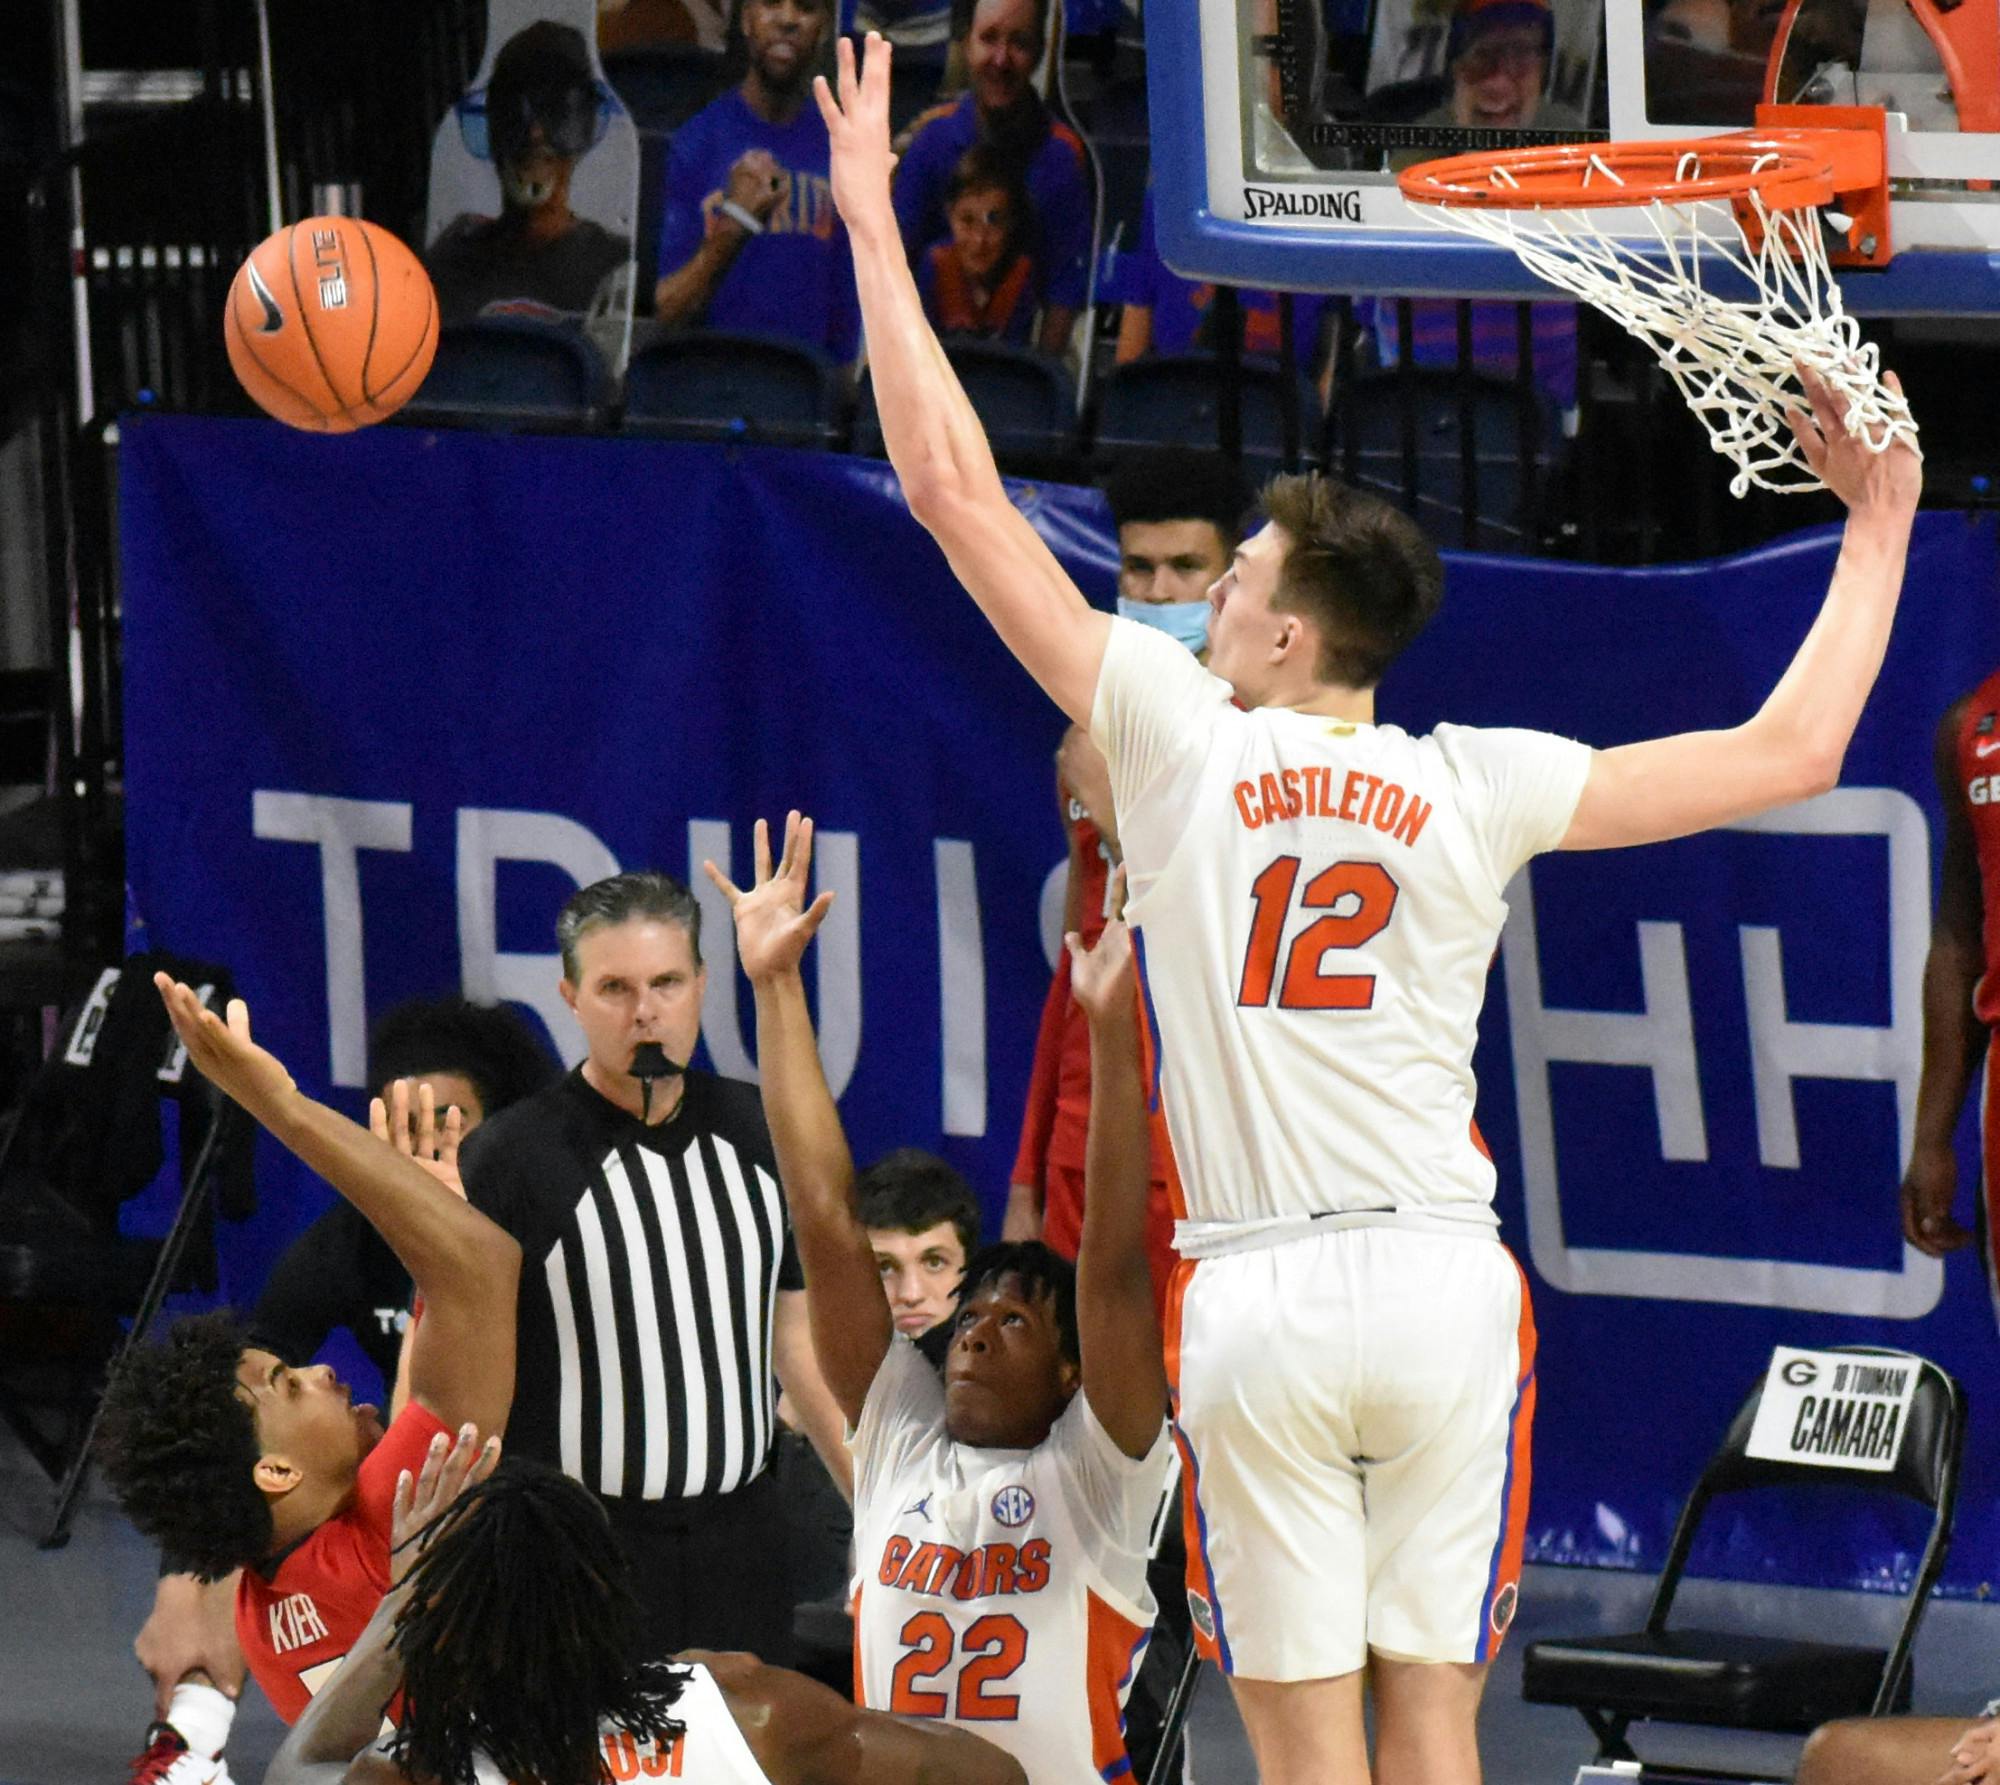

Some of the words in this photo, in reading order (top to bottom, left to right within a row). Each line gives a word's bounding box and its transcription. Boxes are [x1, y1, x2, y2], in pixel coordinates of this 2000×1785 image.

[1243, 187, 1361, 223] SPALDING
[312, 229, 347, 309] ELITE
[1233, 766, 1432, 848] CASTLETON
[1237, 854, 1400, 1009] 12
[1790, 1395, 1901, 1461] CAMARA
[992, 1486, 1035, 1526] SEC
[879, 1534, 1053, 1601] GATORS
[269, 1592, 329, 1655] KIER
[890, 1610, 1029, 1721] 22
